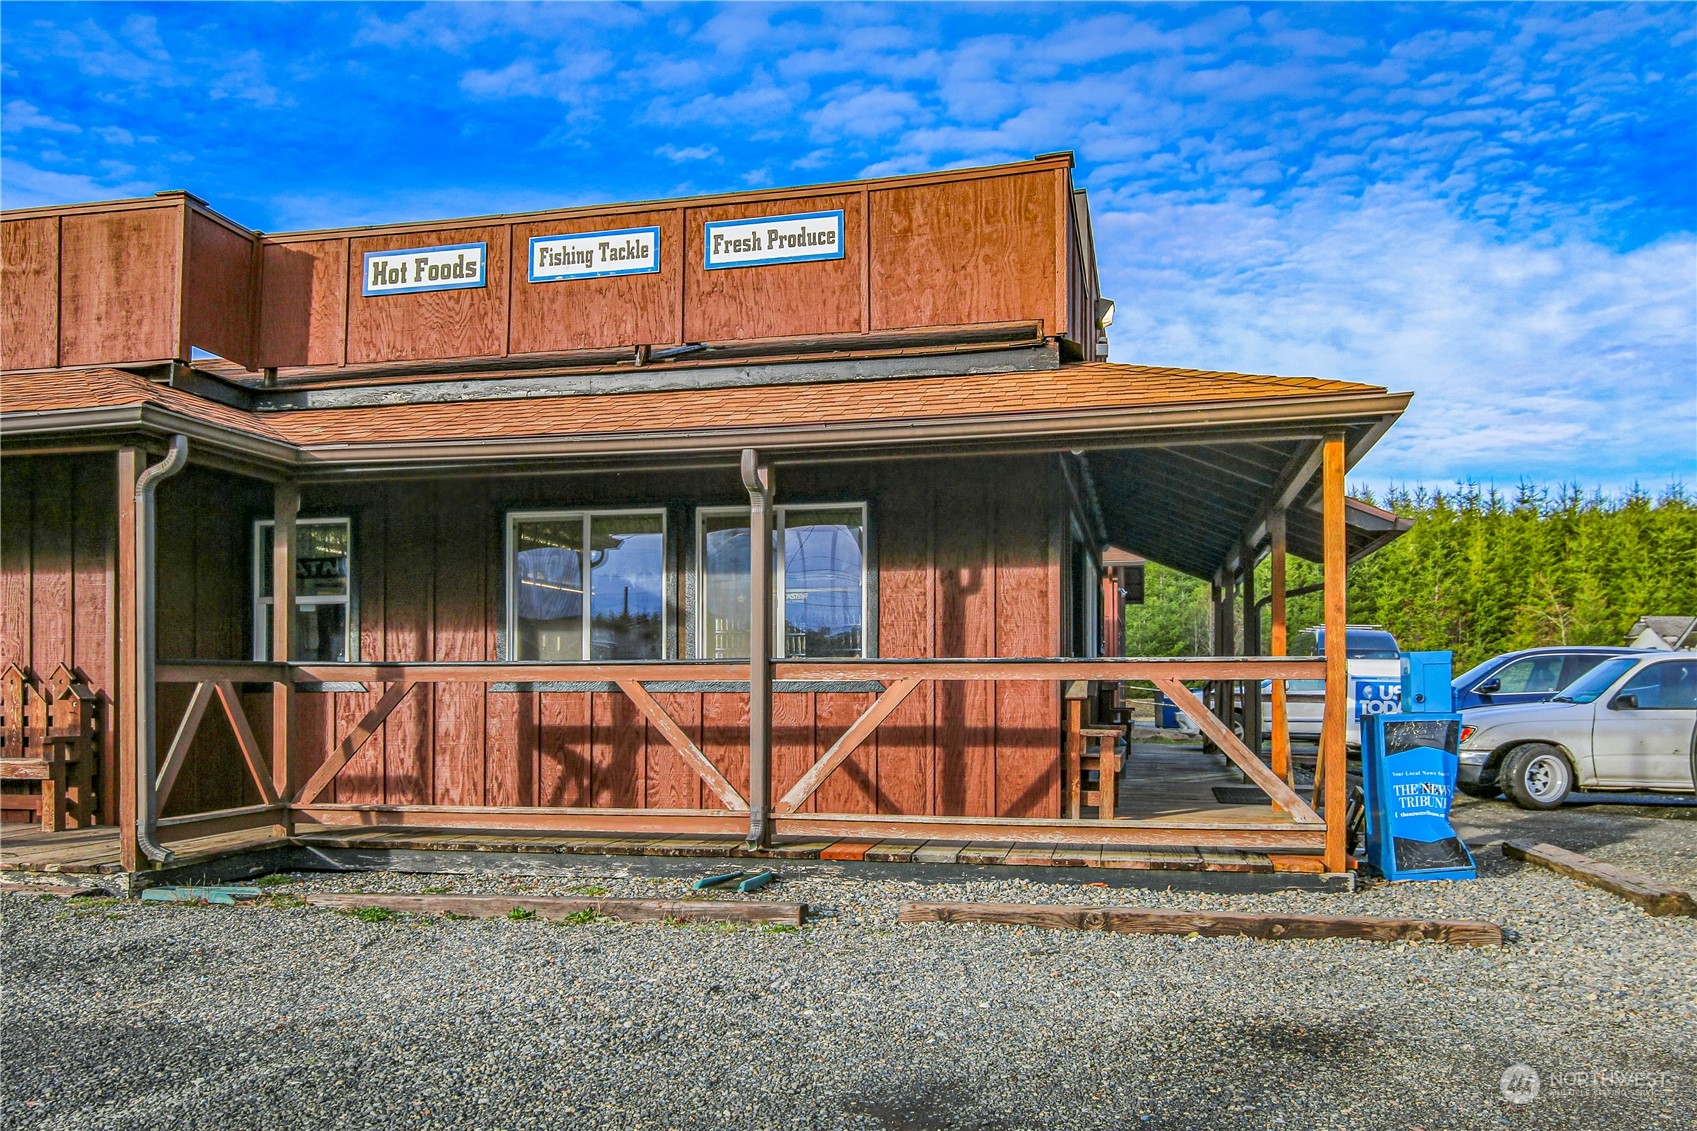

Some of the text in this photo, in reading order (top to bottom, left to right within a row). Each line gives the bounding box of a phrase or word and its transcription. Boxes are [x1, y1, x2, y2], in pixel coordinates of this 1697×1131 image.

[539, 239, 649, 268] Fishing Tackle
[713, 227, 836, 254] Fresh Produce
[372, 254, 477, 286] Hot Foods
[1379, 685, 1402, 700] US
[1392, 783, 1451, 796] THE NEWS
